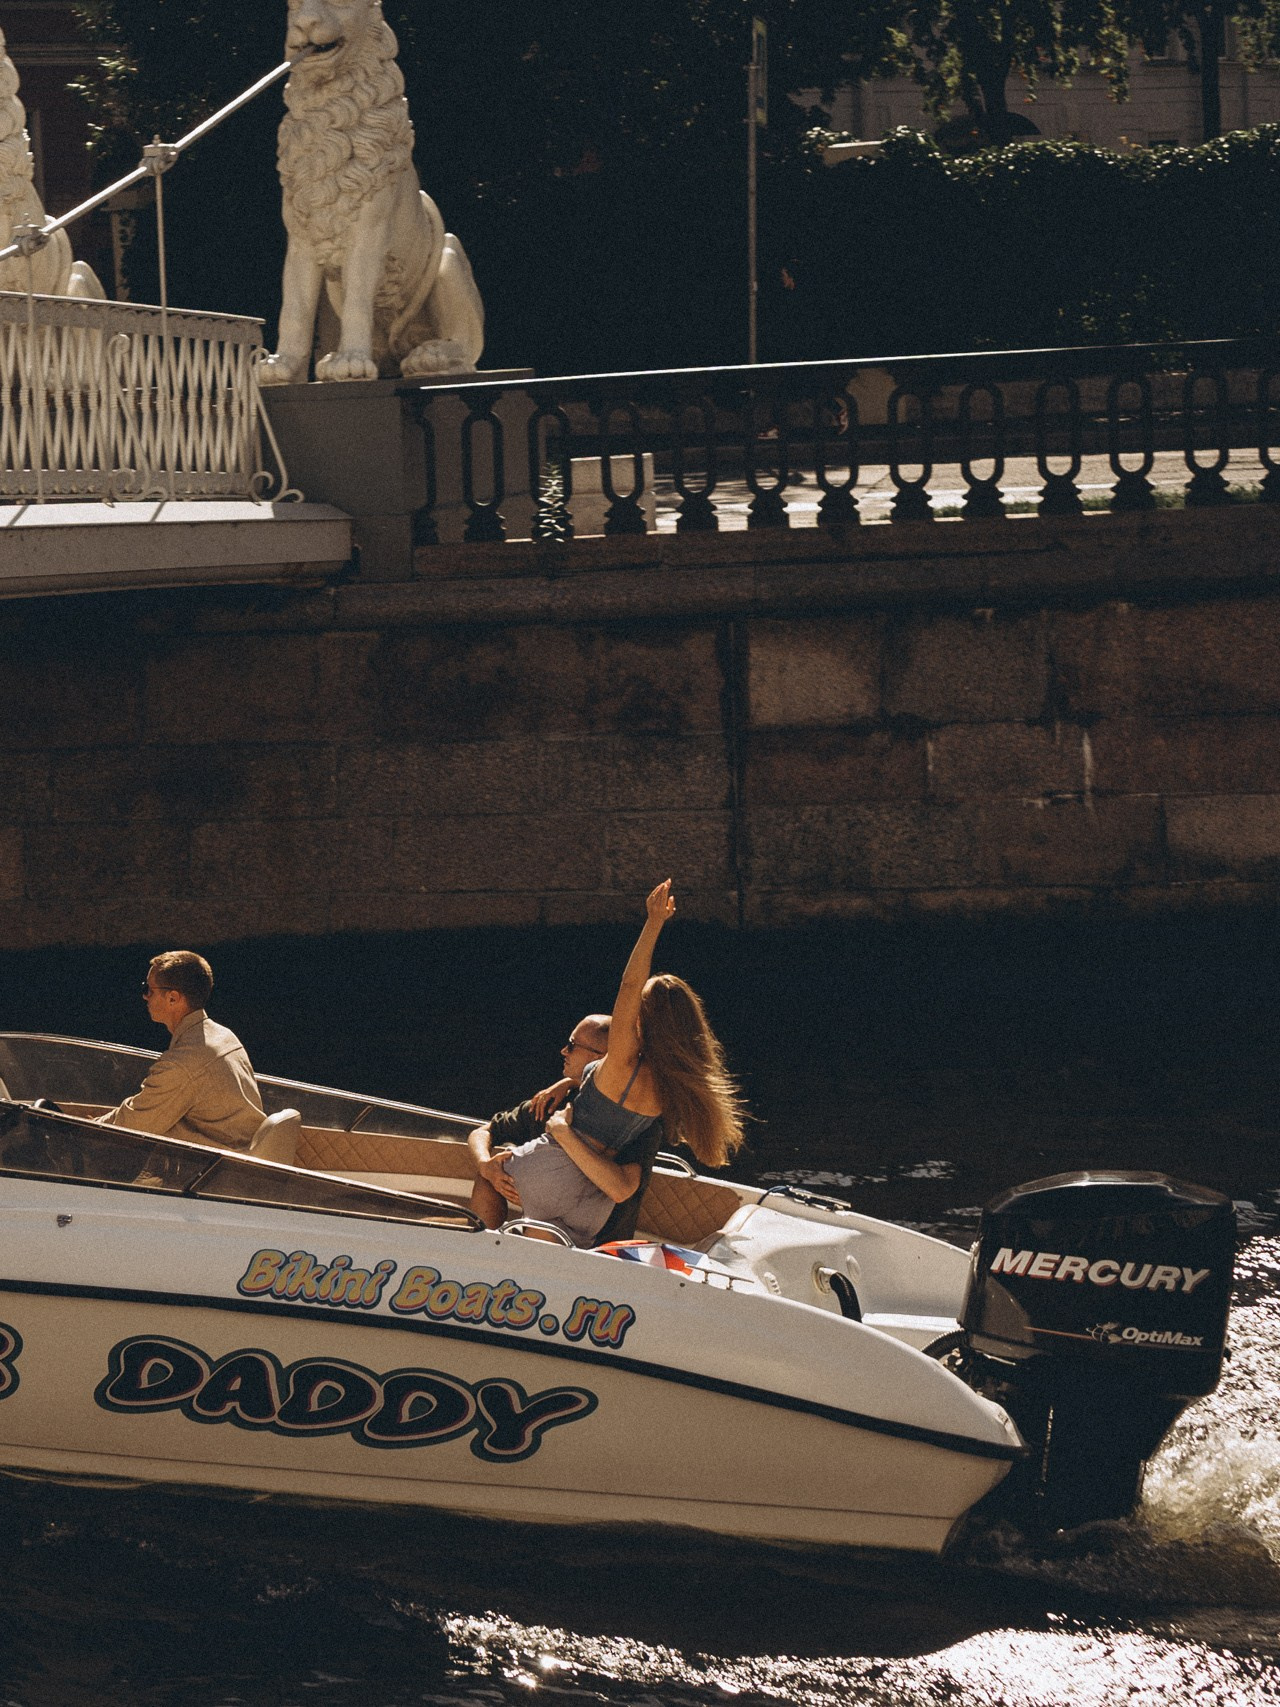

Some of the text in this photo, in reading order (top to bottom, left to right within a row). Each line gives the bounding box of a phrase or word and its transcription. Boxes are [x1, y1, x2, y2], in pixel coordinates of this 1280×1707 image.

[237, 1249, 397, 1307] Bikini
[990, 1247, 1211, 1294] MERCURY
[1122, 1326, 1204, 1347] OptiMax
[94, 1334, 599, 1464] DADDY
